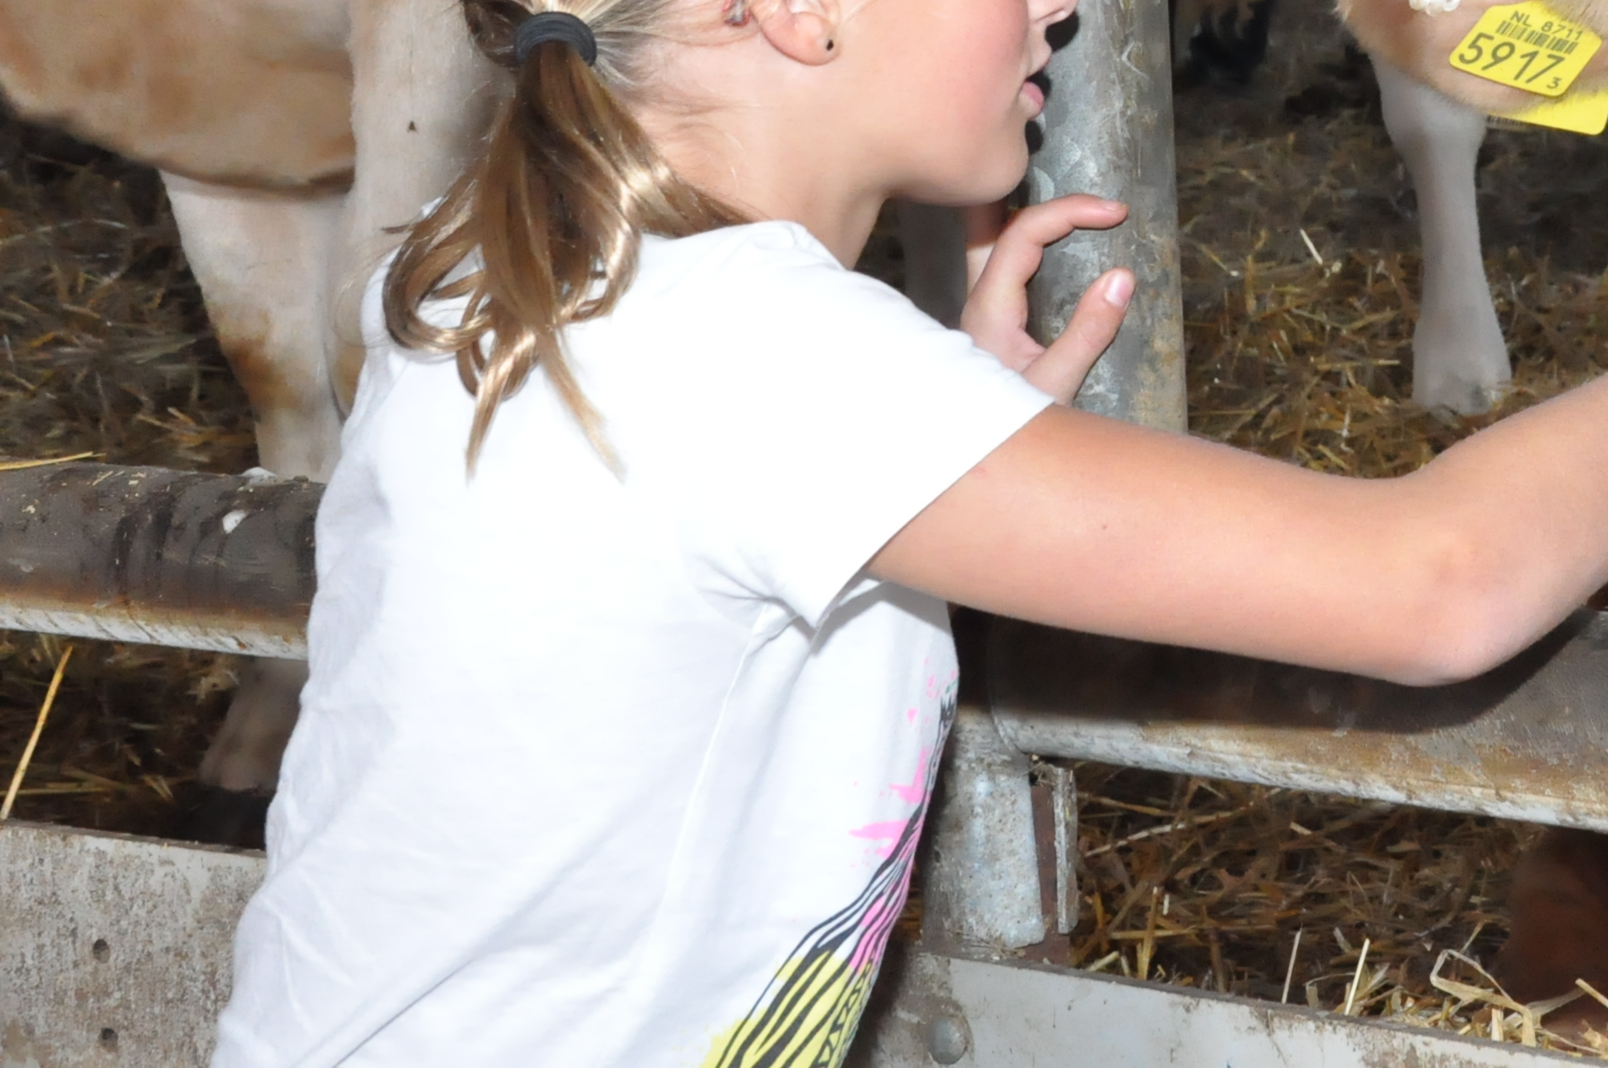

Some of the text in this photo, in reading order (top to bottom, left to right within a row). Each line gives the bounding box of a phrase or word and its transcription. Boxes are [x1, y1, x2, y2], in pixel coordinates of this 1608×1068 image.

[1510, 10, 1583, 41] NL 8711
[1458, 32, 1565, 89] 5917 3
